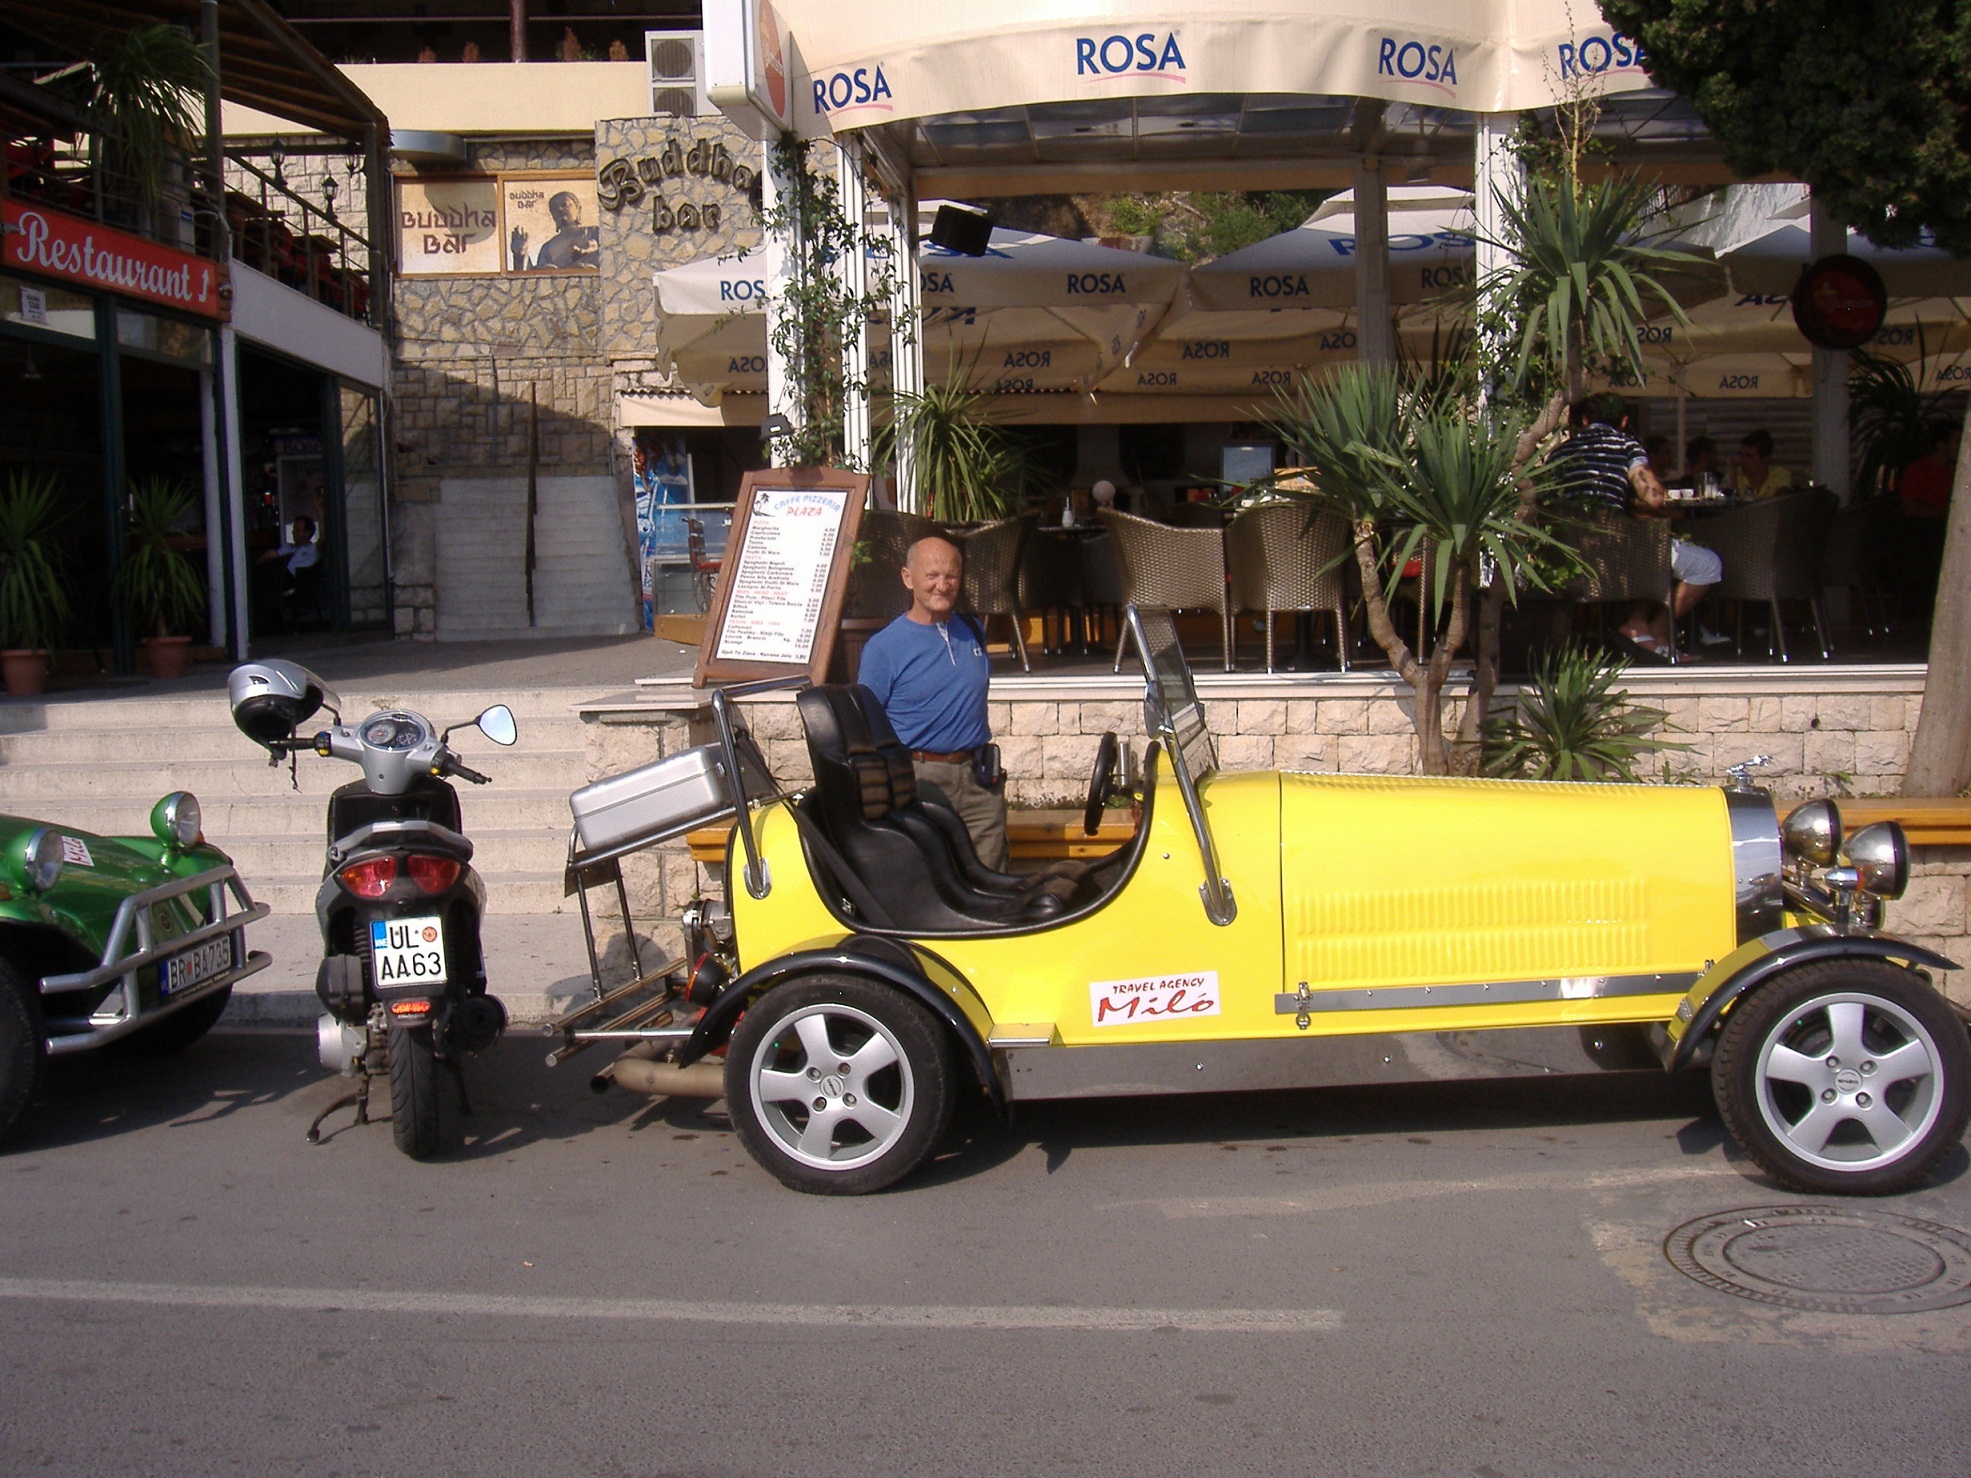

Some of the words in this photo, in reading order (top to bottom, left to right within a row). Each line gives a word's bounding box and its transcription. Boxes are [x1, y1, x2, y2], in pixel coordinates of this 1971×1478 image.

[1076, 32, 1186, 75] ROSA
[1379, 38, 1457, 85] ROSA
[813, 64, 892, 114] ROSA
[598, 138, 754, 210] Buddha
[653, 195, 722, 232] bar
[17, 211, 193, 301] Restaurant
[720, 279, 766, 301] ROS
[1067, 273, 1126, 294] ROSA
[1250, 275, 1310, 297] ROSA
[786, 506, 823, 516] PLAZA
[803, 495, 841, 513] PIZZERIA
[390, 925, 419, 949] UL
[170, 958, 186, 989] BR
[381, 952, 442, 980] AA63
[1112, 981, 1156, 995] TRAVEL
[1159, 977, 1205, 990] AGENCY
